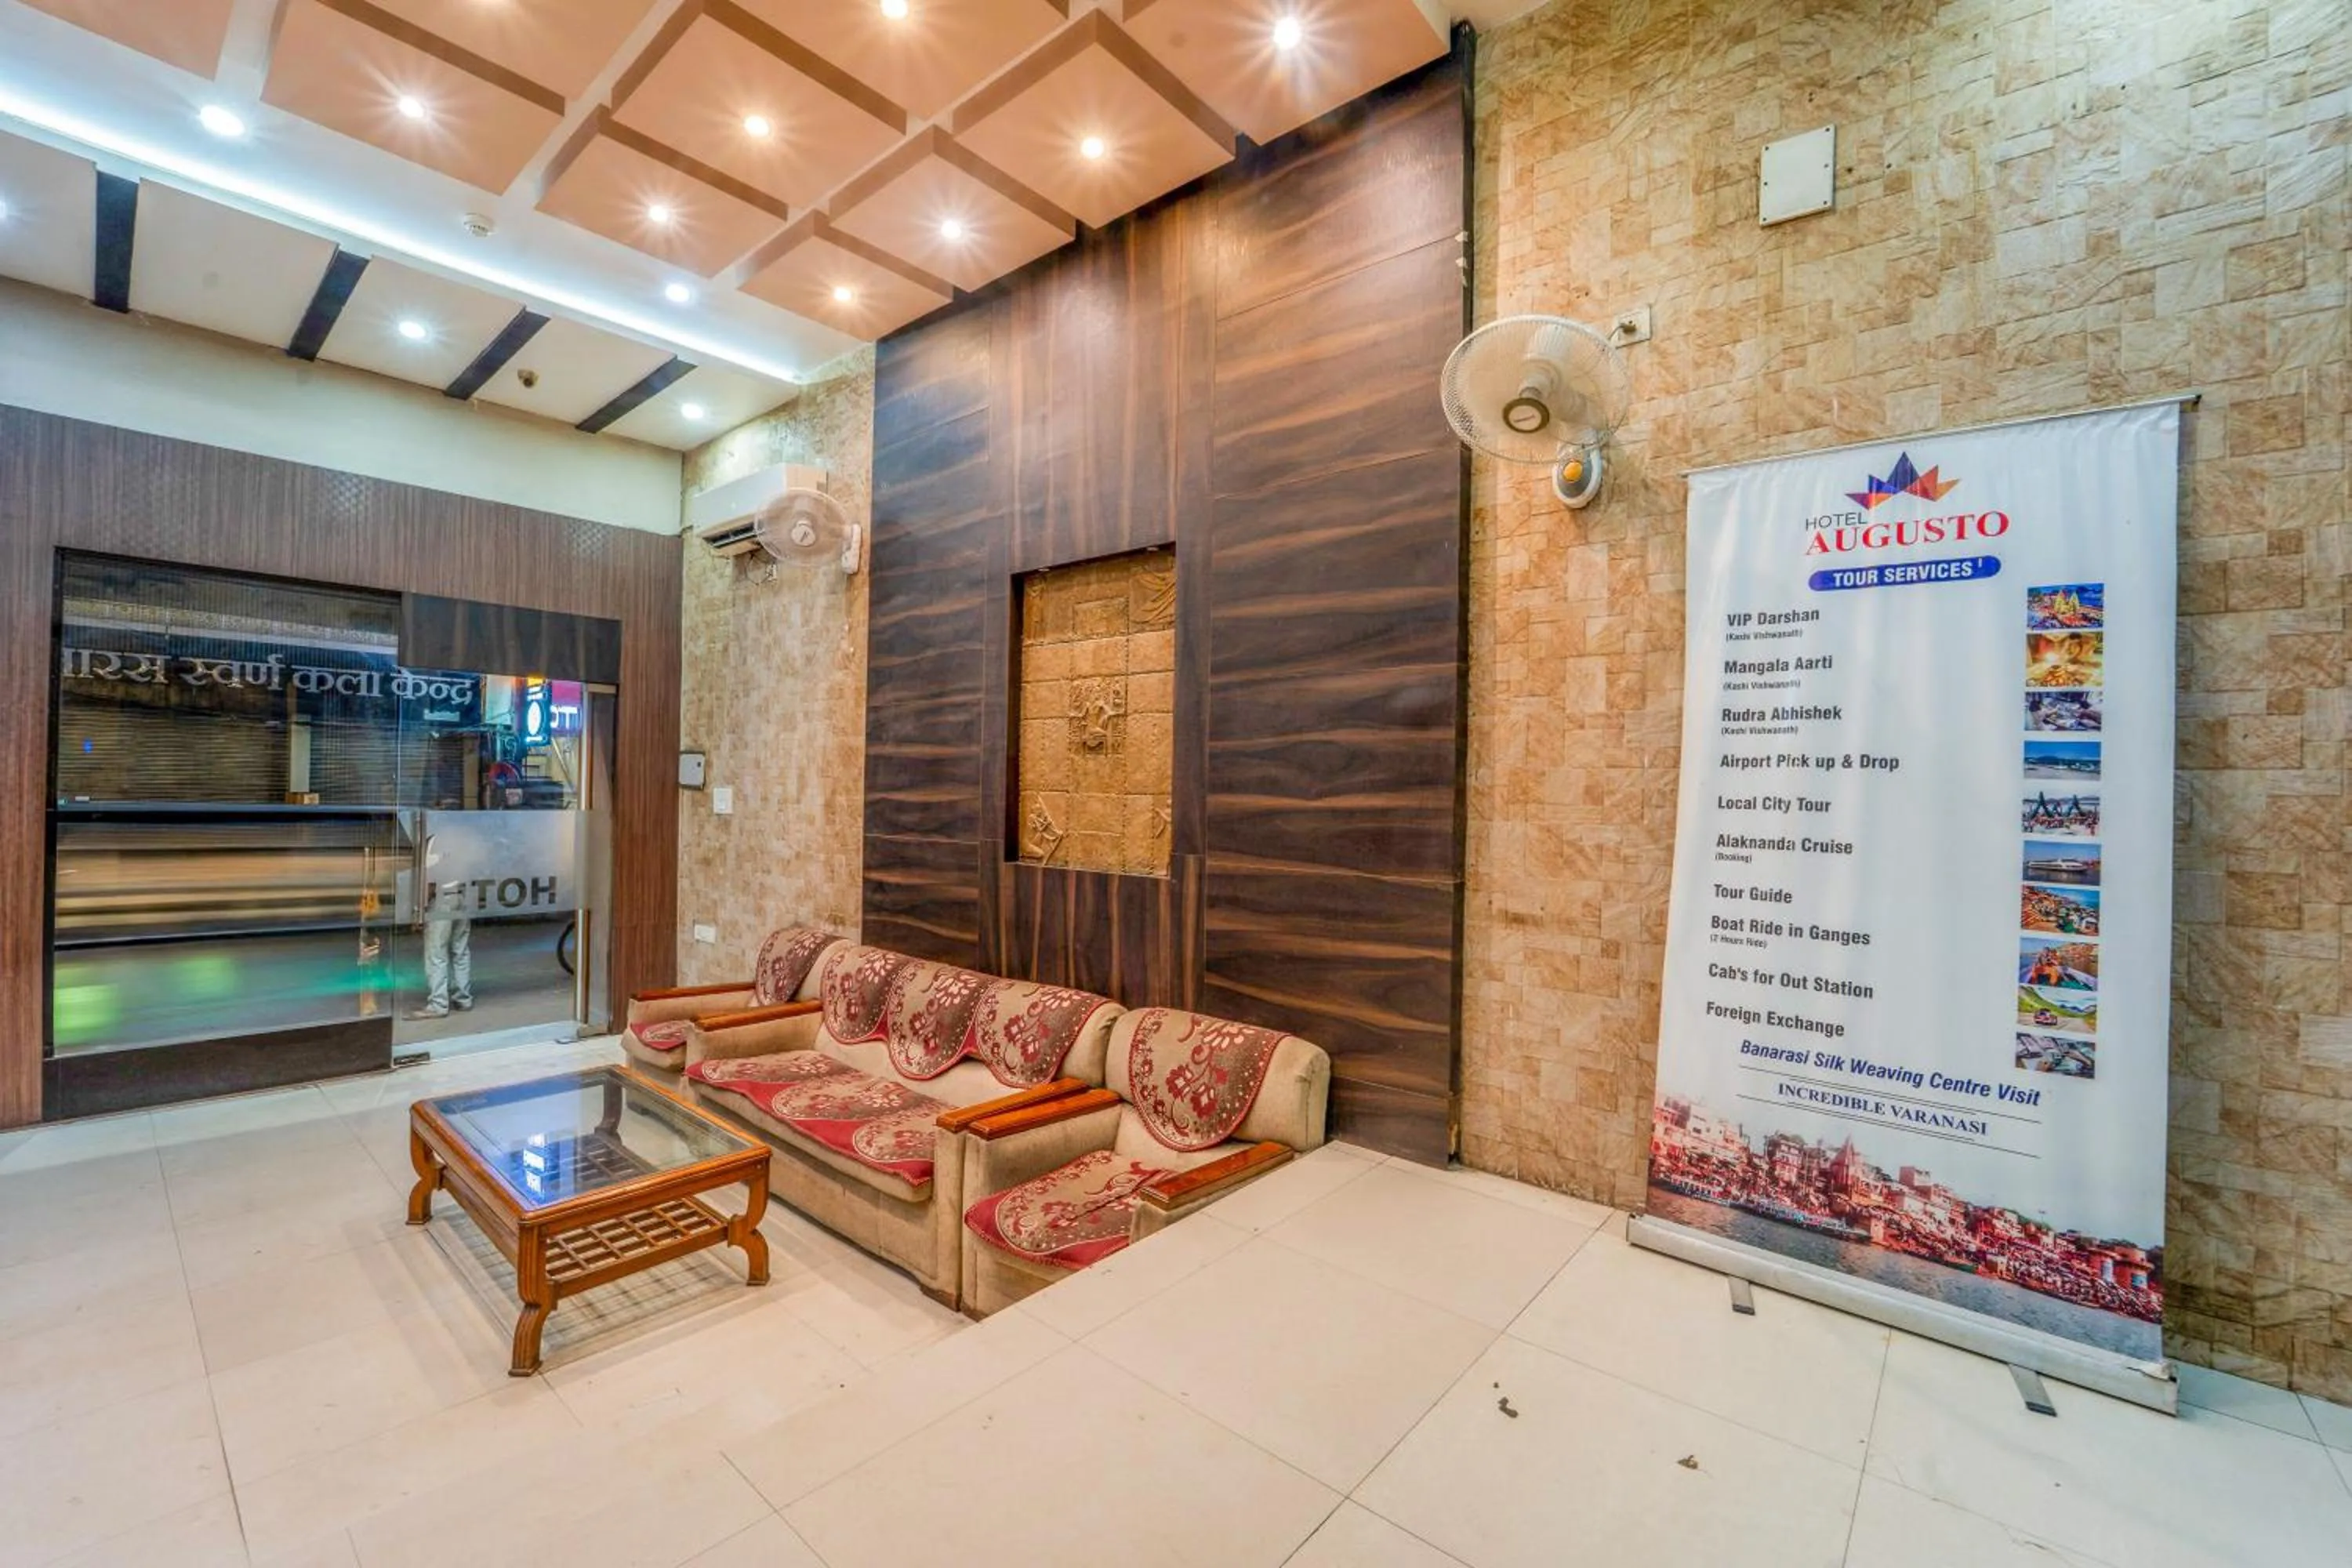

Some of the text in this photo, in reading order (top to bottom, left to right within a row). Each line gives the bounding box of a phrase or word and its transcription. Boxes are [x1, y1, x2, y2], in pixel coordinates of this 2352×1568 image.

[1806, 512, 1867, 531] HOTEL
[1806, 510, 2009, 555] AUGUSTO
[1833, 569, 1878, 587] TOUR
[1727, 609, 1820, 626] VIP Darshan
[1724, 655, 1833, 675] Mangala Aarti
[292, 666, 384, 697] कला
[1722, 706, 1842, 722] Rudra Abhishek
[1720, 754, 1900, 772] Airport Pick up & Drop
[1718, 796, 1832, 813] Local City Tour
[1716, 834, 1853, 855] Alaknanda Cruise
[1714, 884, 1793, 903] Tour Guide
[1711, 915, 1871, 946] Boat Ride in Ganges
[1708, 963, 1874, 998] Cab's for Out Station
[1706, 1001, 1845, 1037] Foreign Exchange
[1740, 1040, 2041, 1107] Banarasi Silk Weaving Centre Visit
[1778, 1083, 1988, 1136] INCREDIBLE VARANASI
